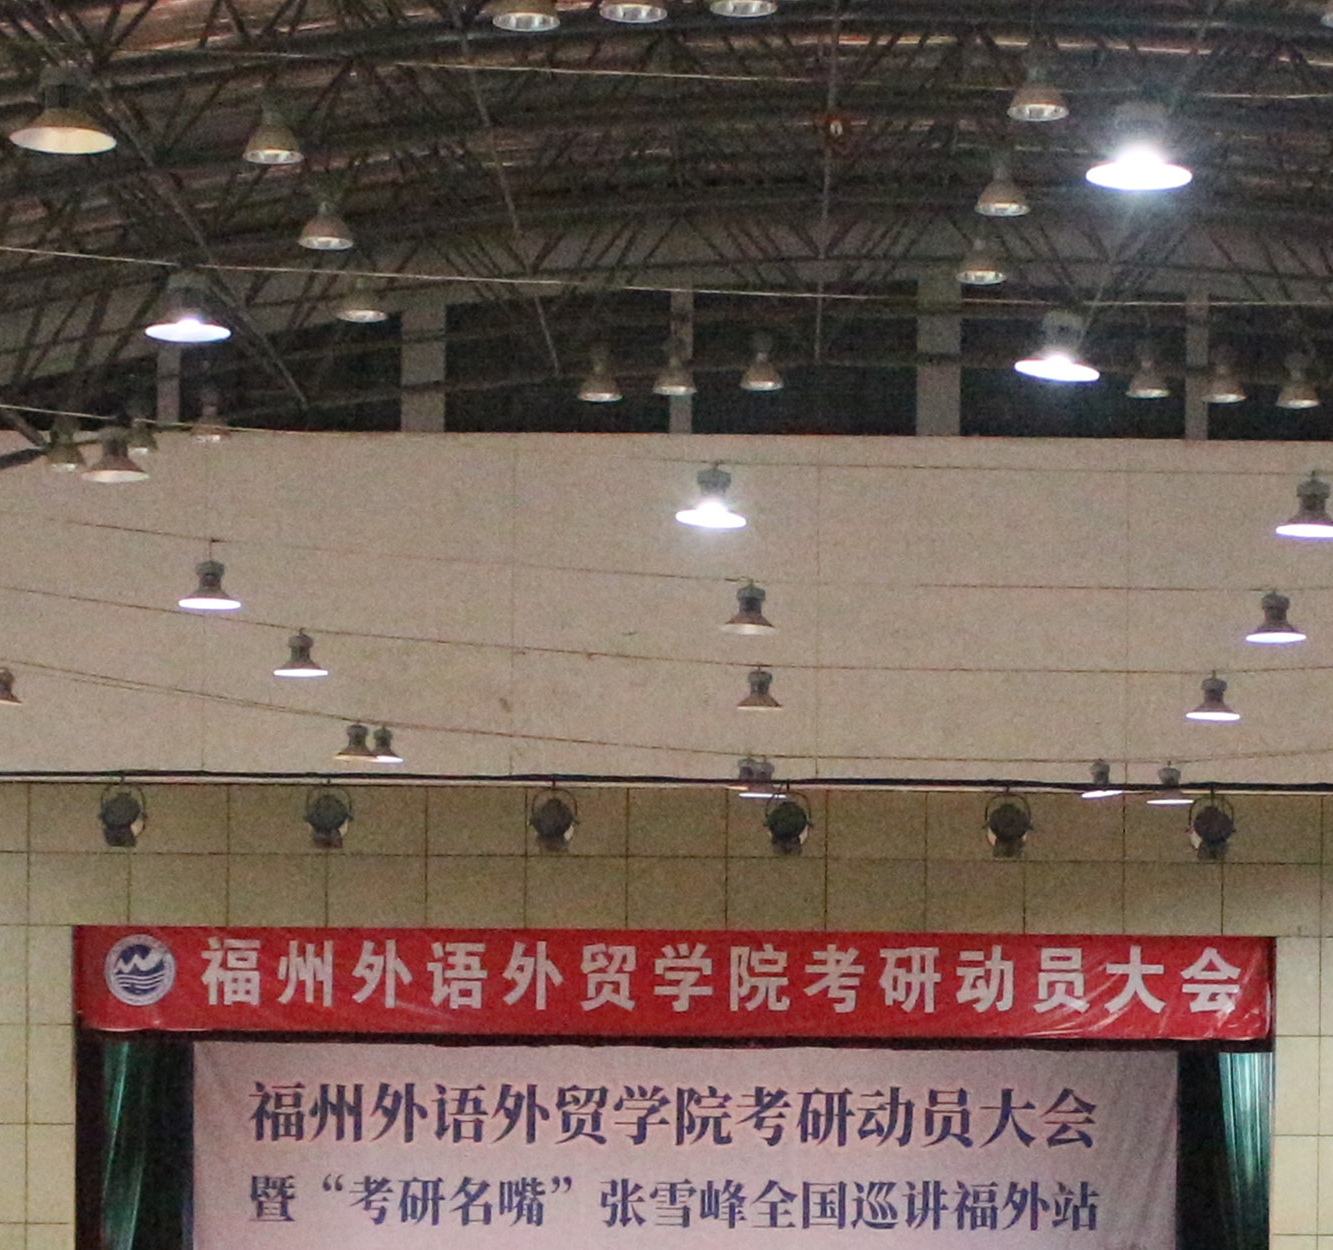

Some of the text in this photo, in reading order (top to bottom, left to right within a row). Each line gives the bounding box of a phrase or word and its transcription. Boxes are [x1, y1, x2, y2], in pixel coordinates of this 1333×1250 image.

[200, 937, 1242, 1014] 福州外语外贸学院考研动员大会
[249, 1080, 1097, 1149] 福州外语外贸学院考研动员大会
